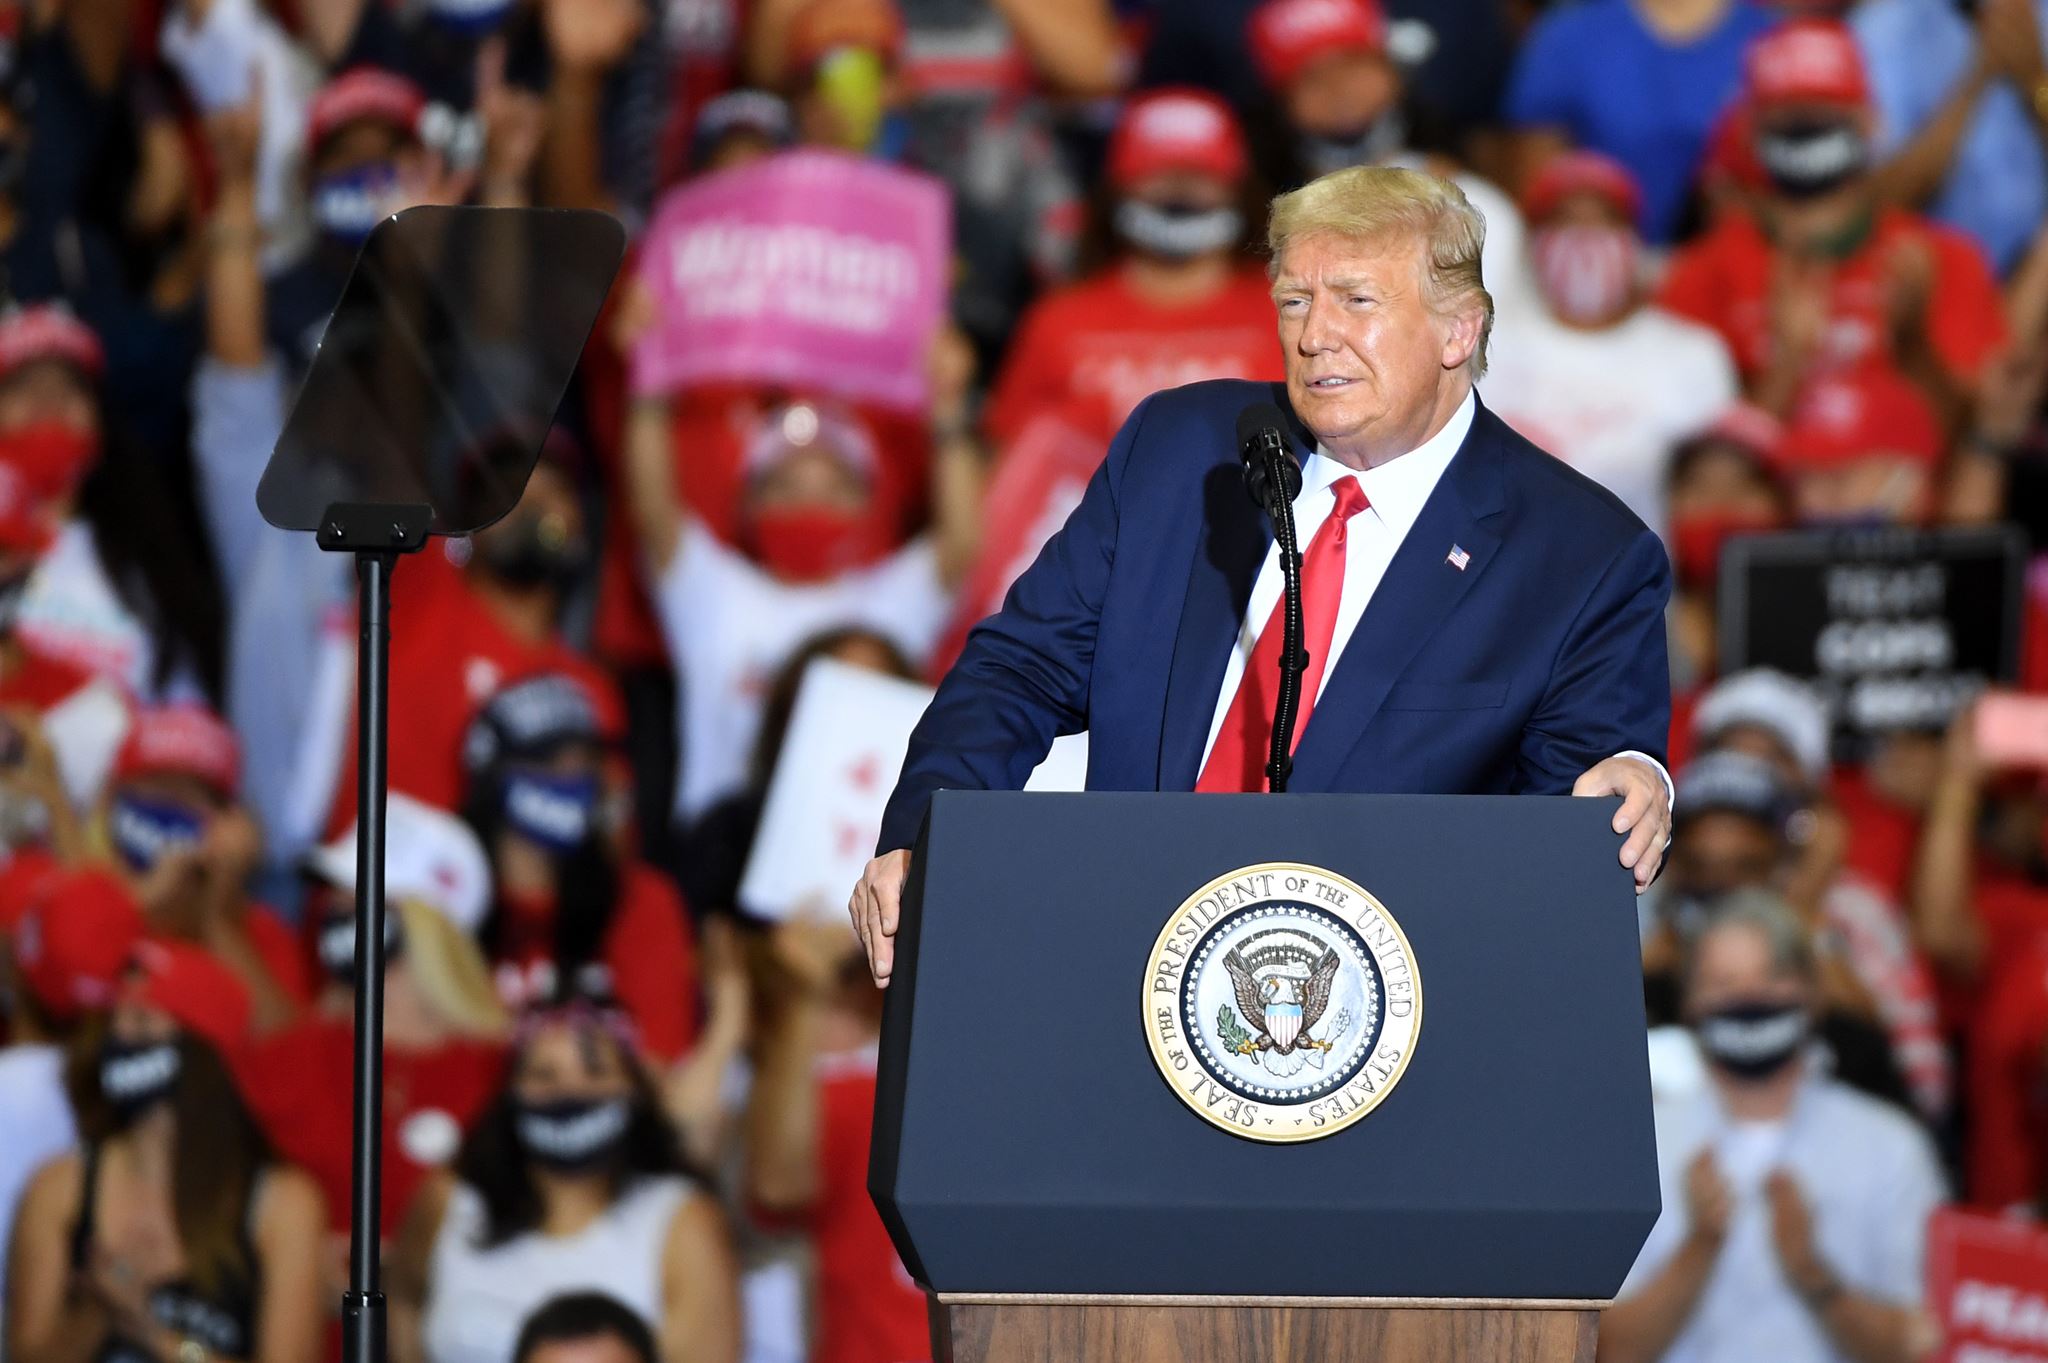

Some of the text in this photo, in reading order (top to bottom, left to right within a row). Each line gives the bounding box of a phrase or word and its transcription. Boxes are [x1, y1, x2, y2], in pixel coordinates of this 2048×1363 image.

[1153, 873, 1412, 1127] SEAL OF THE PRESIDENT OF THE UNITED STATES
